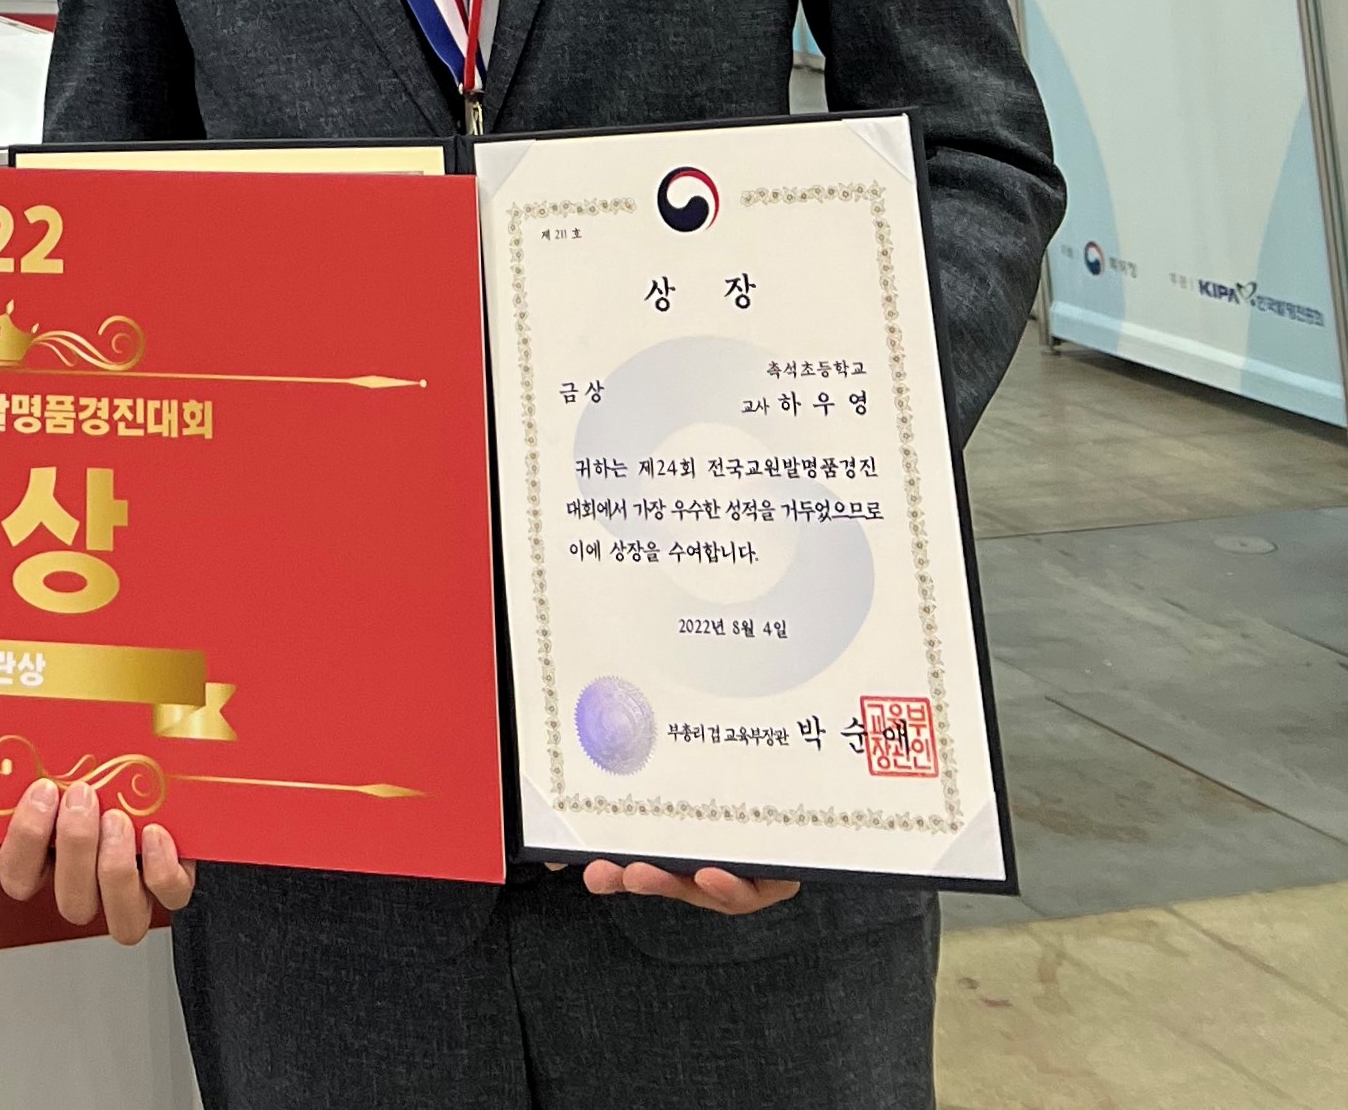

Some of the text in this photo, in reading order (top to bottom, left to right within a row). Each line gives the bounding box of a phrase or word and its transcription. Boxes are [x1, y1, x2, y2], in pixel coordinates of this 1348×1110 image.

[643, 273, 757, 313] 상 장
[766, 359, 868, 380] 촉석초등학교
[558, 380, 605, 404] 금상
[740, 389, 867, 417] 교사 하 우 영
[575, 455, 879, 480] 귀하는 제24회 전국교원발명품경진
[566, 497, 885, 523] 대회에서 가장 우수한 성적을 거두었으므로
[0, 466, 129, 614] 상
[569, 540, 759, 564] 이에 상장을 수여합니다.
[678, 617, 788, 639] 2022년 8월 4일
[667, 723, 706, 743] 부총리
[707, 724, 721, 744] 겸
[723, 726, 790, 747] 교육부장관
[796, 716, 827, 751] 박
[840, 717, 869, 754] 순
